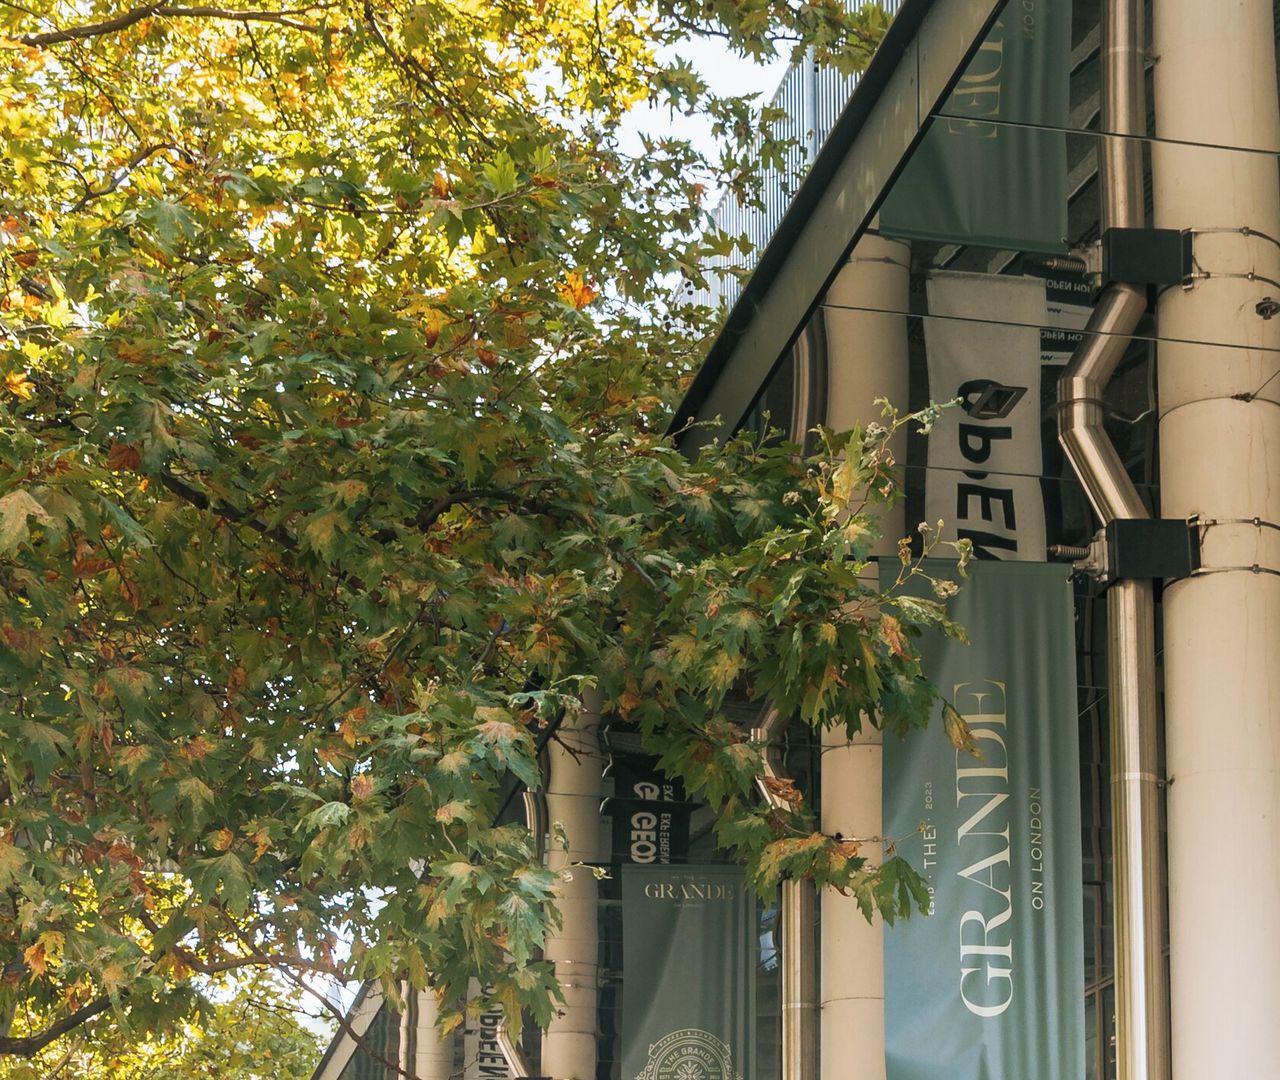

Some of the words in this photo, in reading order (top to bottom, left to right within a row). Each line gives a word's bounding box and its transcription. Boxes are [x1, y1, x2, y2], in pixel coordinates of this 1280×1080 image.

[953, 679, 1014, 1018] GRANDE
[1029, 786, 1043, 873] LONDON
[1031, 879, 1044, 910] ON
[664, 1050, 680, 1066] THE
[681, 1046, 715, 1066] GRANDE
